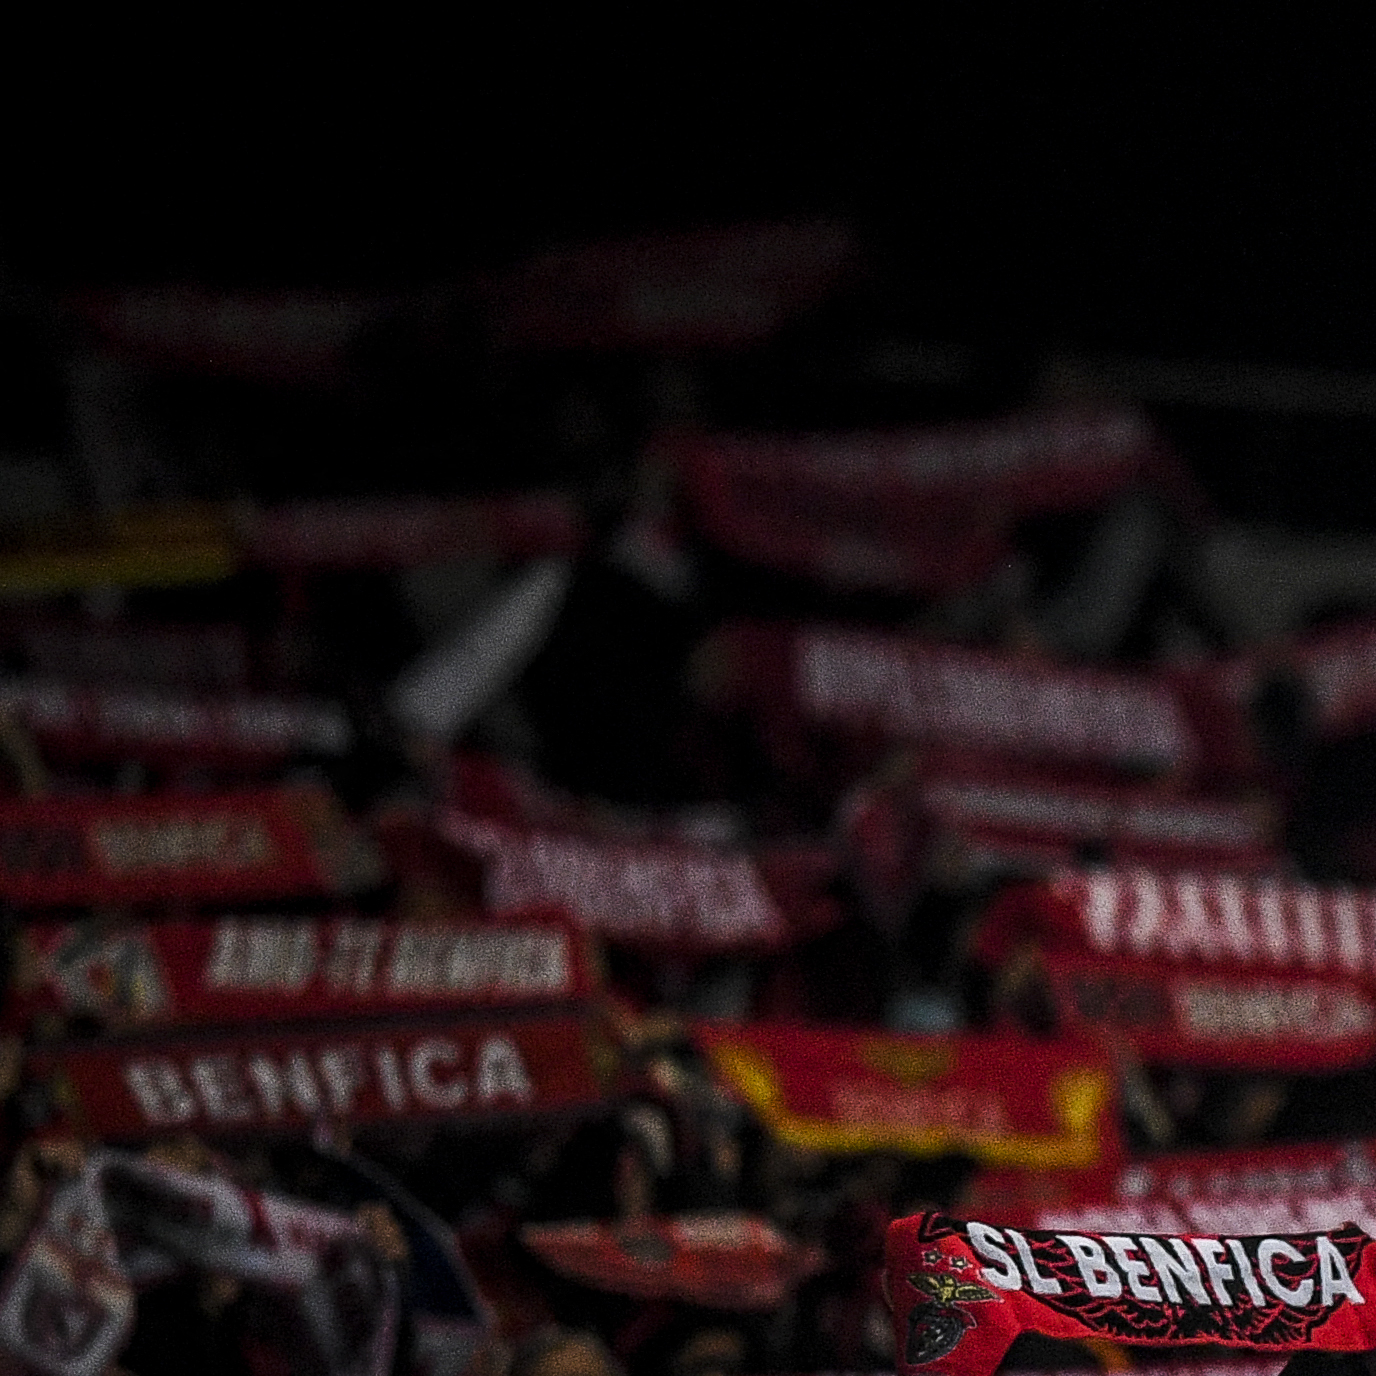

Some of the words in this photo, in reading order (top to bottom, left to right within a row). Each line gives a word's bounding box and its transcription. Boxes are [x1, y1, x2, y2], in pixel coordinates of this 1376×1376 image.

[122, 1035, 534, 1126] BENFICA
[966, 1221, 1062, 1296] SL
[1062, 1234, 1365, 1306] BENFICA
